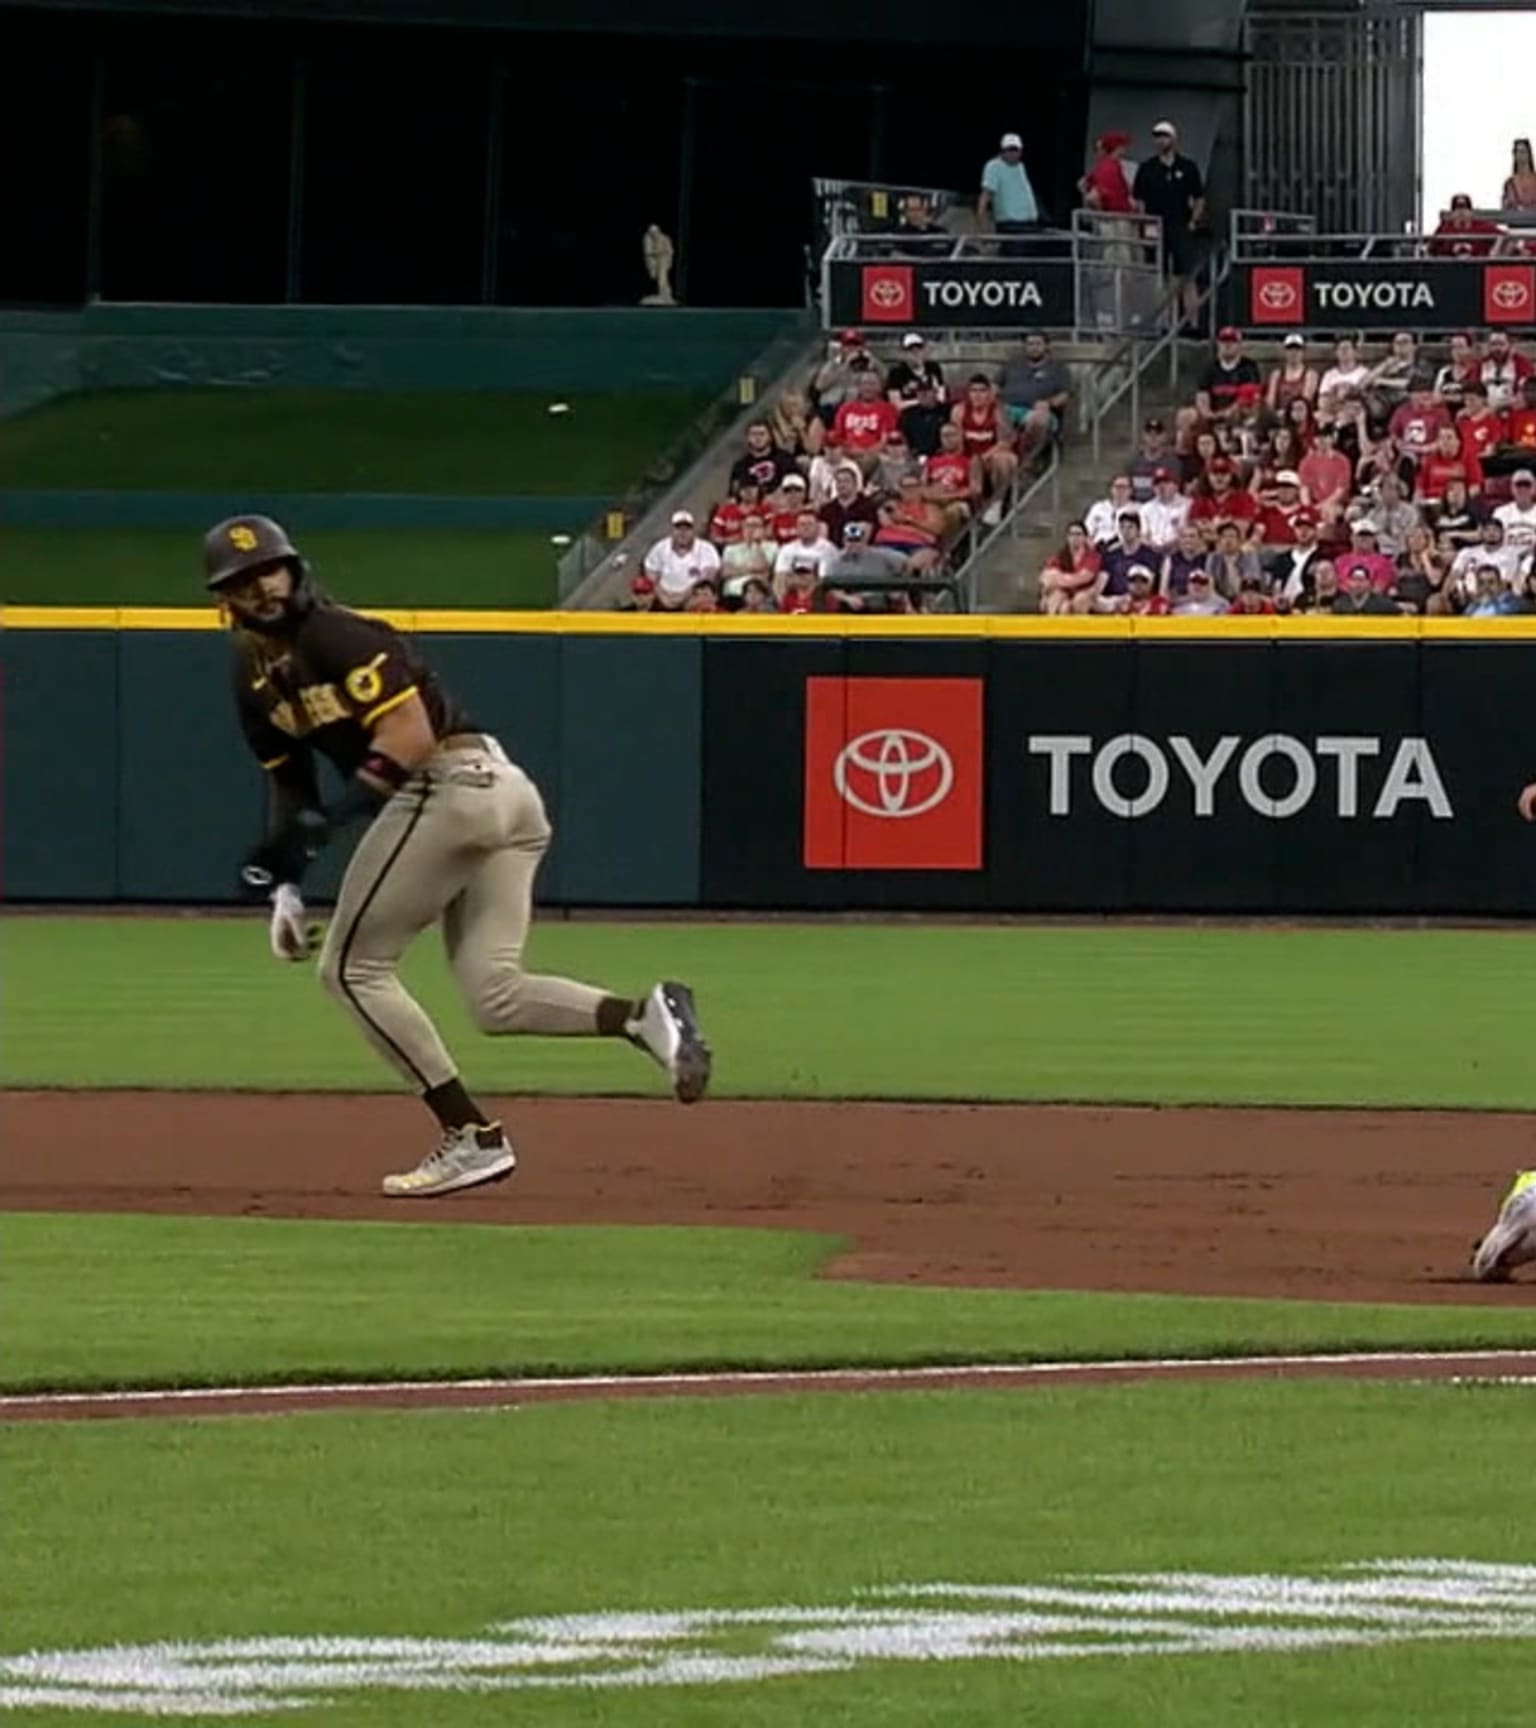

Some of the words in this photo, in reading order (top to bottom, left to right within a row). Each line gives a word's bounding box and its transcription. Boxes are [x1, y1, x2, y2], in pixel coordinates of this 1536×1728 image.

[922, 280, 1042, 307] TOYOTA
[1314, 282, 1434, 308] TOYOTA
[1028, 734, 1453, 818] TOYOTA
